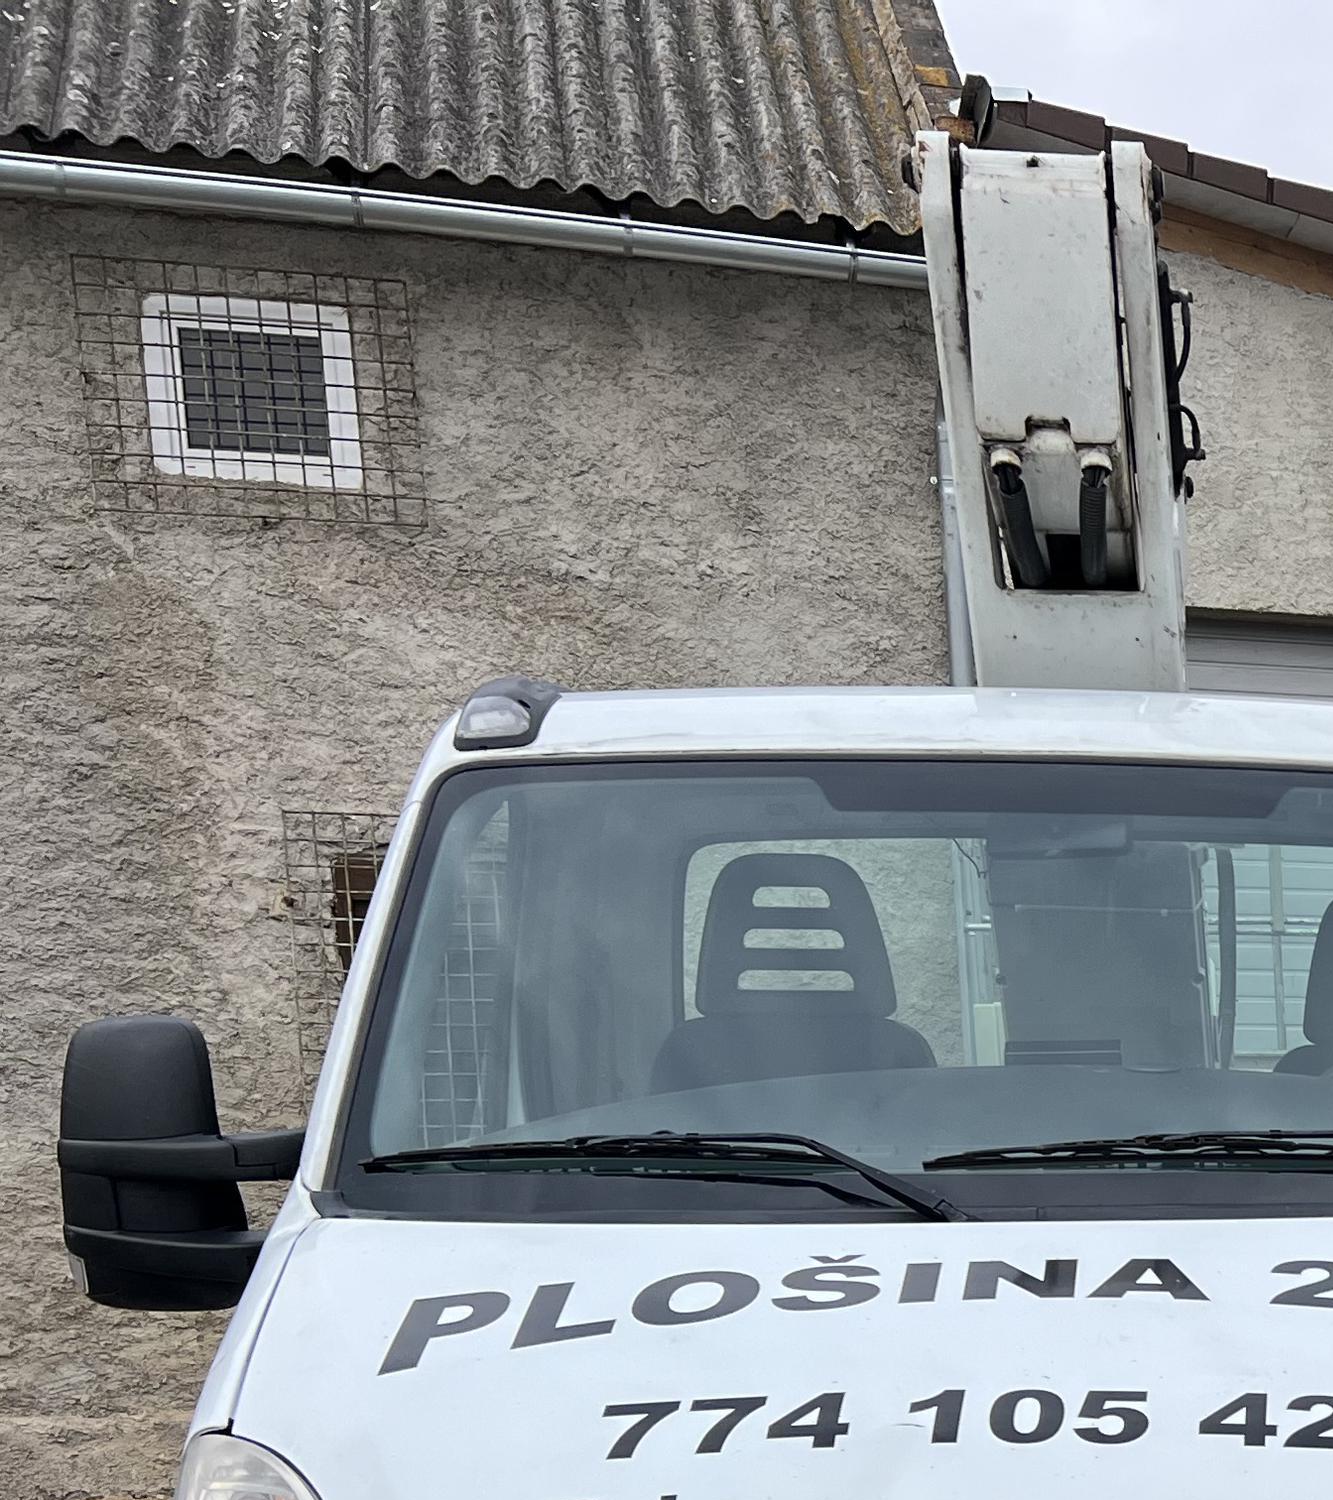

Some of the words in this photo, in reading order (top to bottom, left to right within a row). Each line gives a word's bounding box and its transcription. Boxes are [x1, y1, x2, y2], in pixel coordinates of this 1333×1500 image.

[376, 1253, 1212, 1377] PLOŠINA
[602, 1391, 850, 1461] 774
[906, 1388, 1150, 1445] 105
